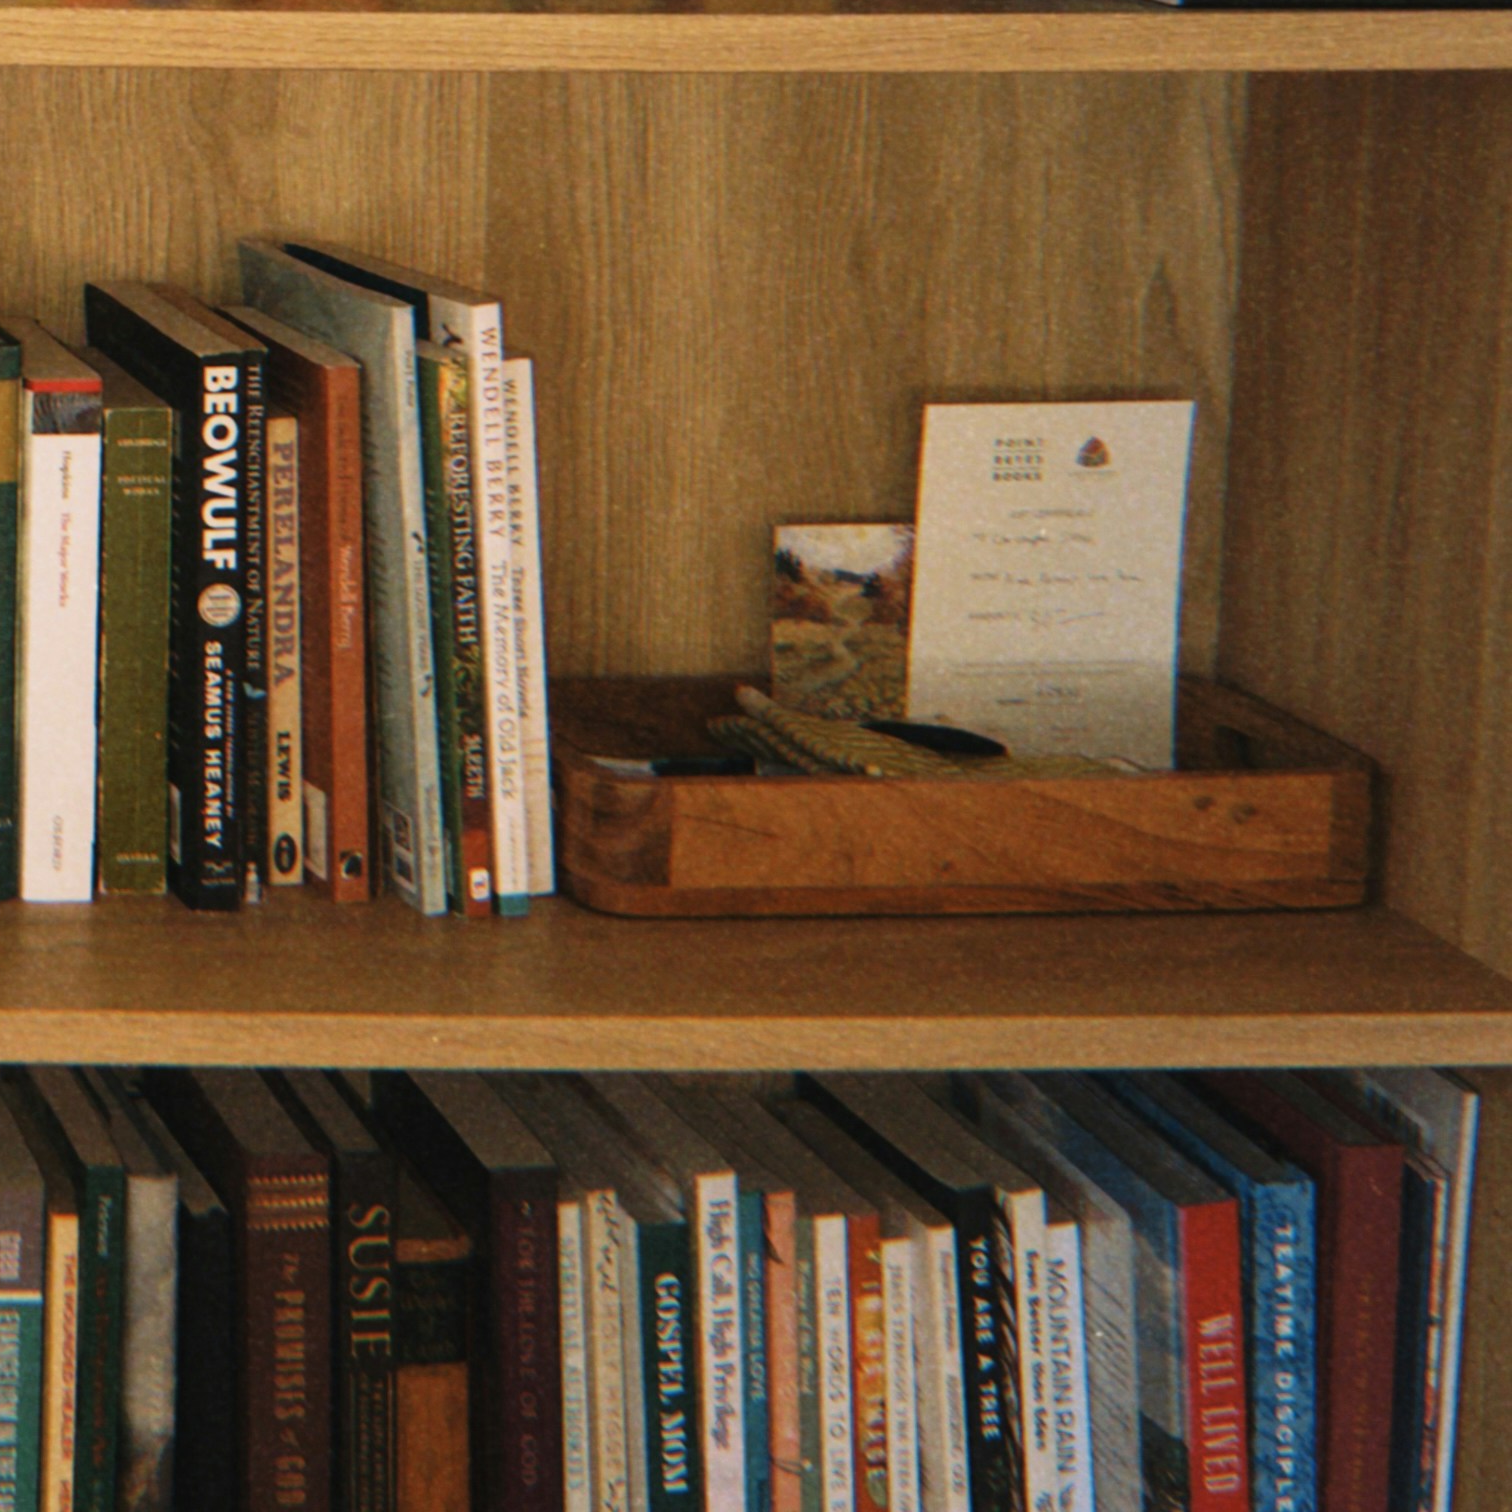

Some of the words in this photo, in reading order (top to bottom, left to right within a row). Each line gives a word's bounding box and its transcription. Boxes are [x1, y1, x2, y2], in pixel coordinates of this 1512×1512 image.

[481, 326, 500, 448] WENDELL
[201, 366, 237, 570] BEOWULF
[449, 411, 471, 570] REFORESTING
[485, 458, 505, 541] BERRY
[273, 442, 293, 686] PERELANDRA
[454, 576, 474, 644] FAITH
[202, 641, 222, 737] SEAMUS
[202, 748, 220, 848] HEANEY
[276, 730, 291, 803] LEWIS
[349, 1204, 392, 1356] SUSIE
[654, 1273, 684, 1400] GOSPEL
[1198, 1313, 1236, 1396] WELL
[664, 1406, 688, 1494] MOM
[1201, 1405, 1238, 1495] LIVED
